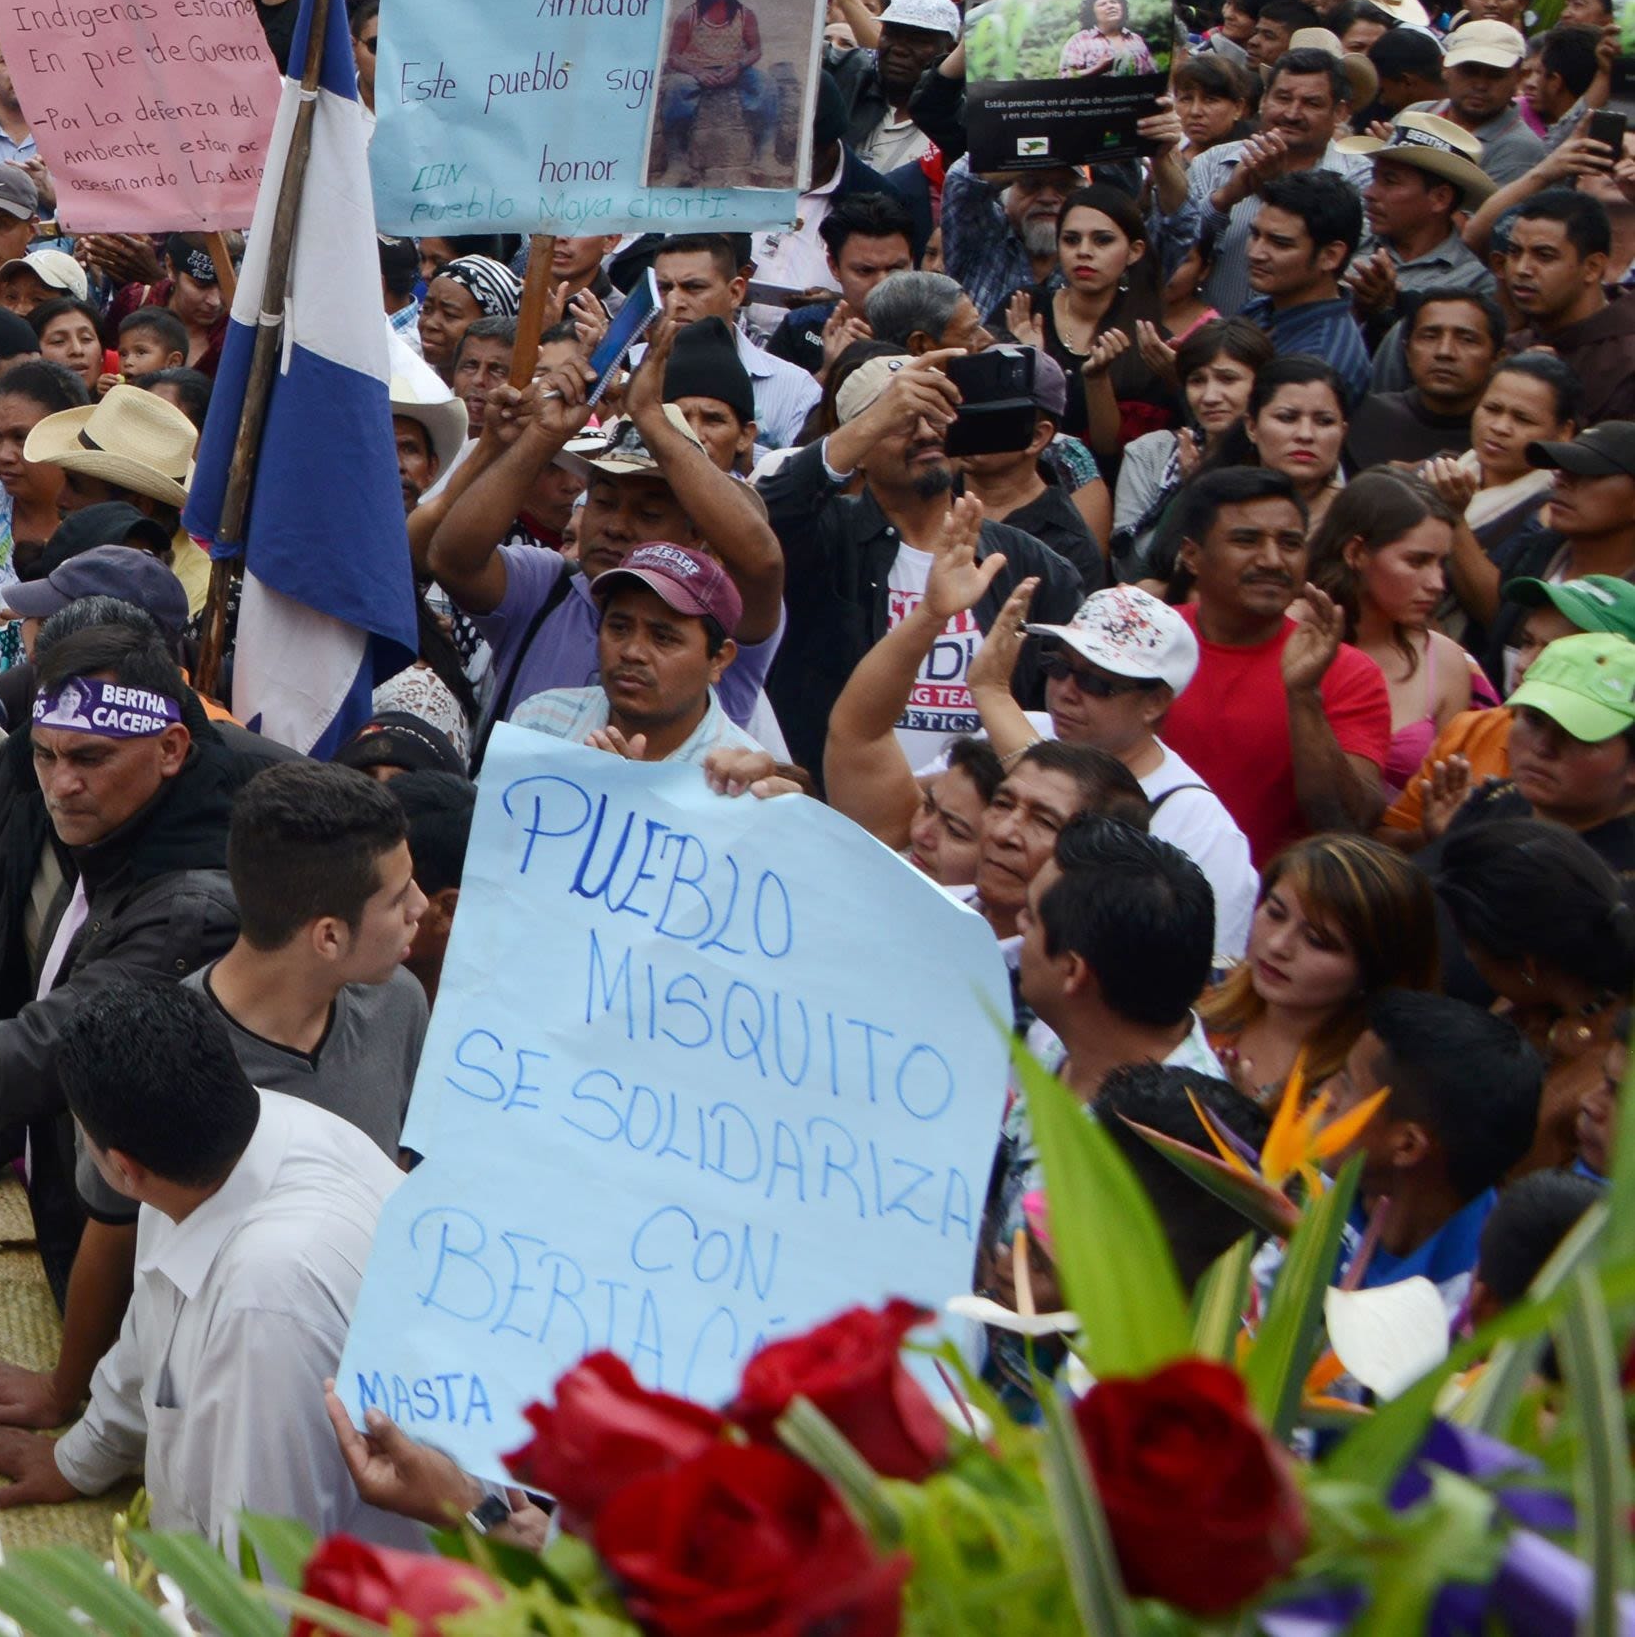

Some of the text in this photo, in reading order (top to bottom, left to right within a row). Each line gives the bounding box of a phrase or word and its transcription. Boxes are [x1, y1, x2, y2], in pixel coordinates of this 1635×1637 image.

[29, 48, 66, 73] En
[83, 44, 135, 87] pie
[401, 52, 569, 114] Este pueblo
[229, 96, 258, 119] del
[102, 683, 168, 715] BERTHA
[936, 689, 972, 705] TEA
[501, 773, 796, 961] PUEBLO
[584, 929, 955, 1122] MISQUITO
[445, 1027, 976, 1243] SE SOLIDARIZA
[631, 1205, 780, 1302] CON
[408, 1207, 664, 1391] BERTA
[355, 1369, 493, 1426] MASTA
